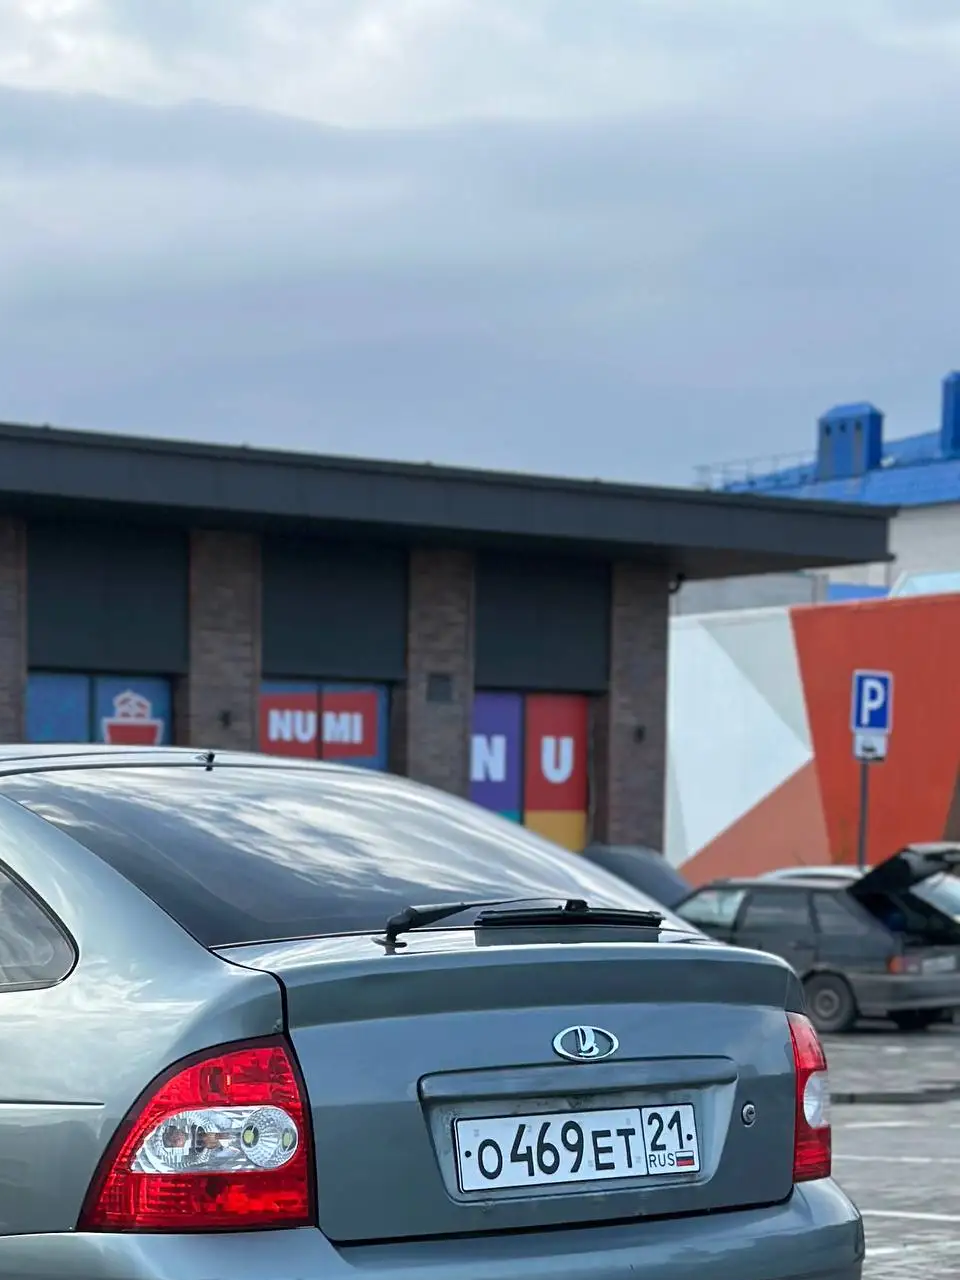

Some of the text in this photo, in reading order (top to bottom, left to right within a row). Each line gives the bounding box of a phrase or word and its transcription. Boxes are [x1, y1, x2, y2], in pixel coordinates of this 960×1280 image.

[861, 679, 885, 725] P
[268, 709, 363, 744] NUMI
[647, 1110, 684, 1151] 21
[648, 1152, 675, 1168] RUS
